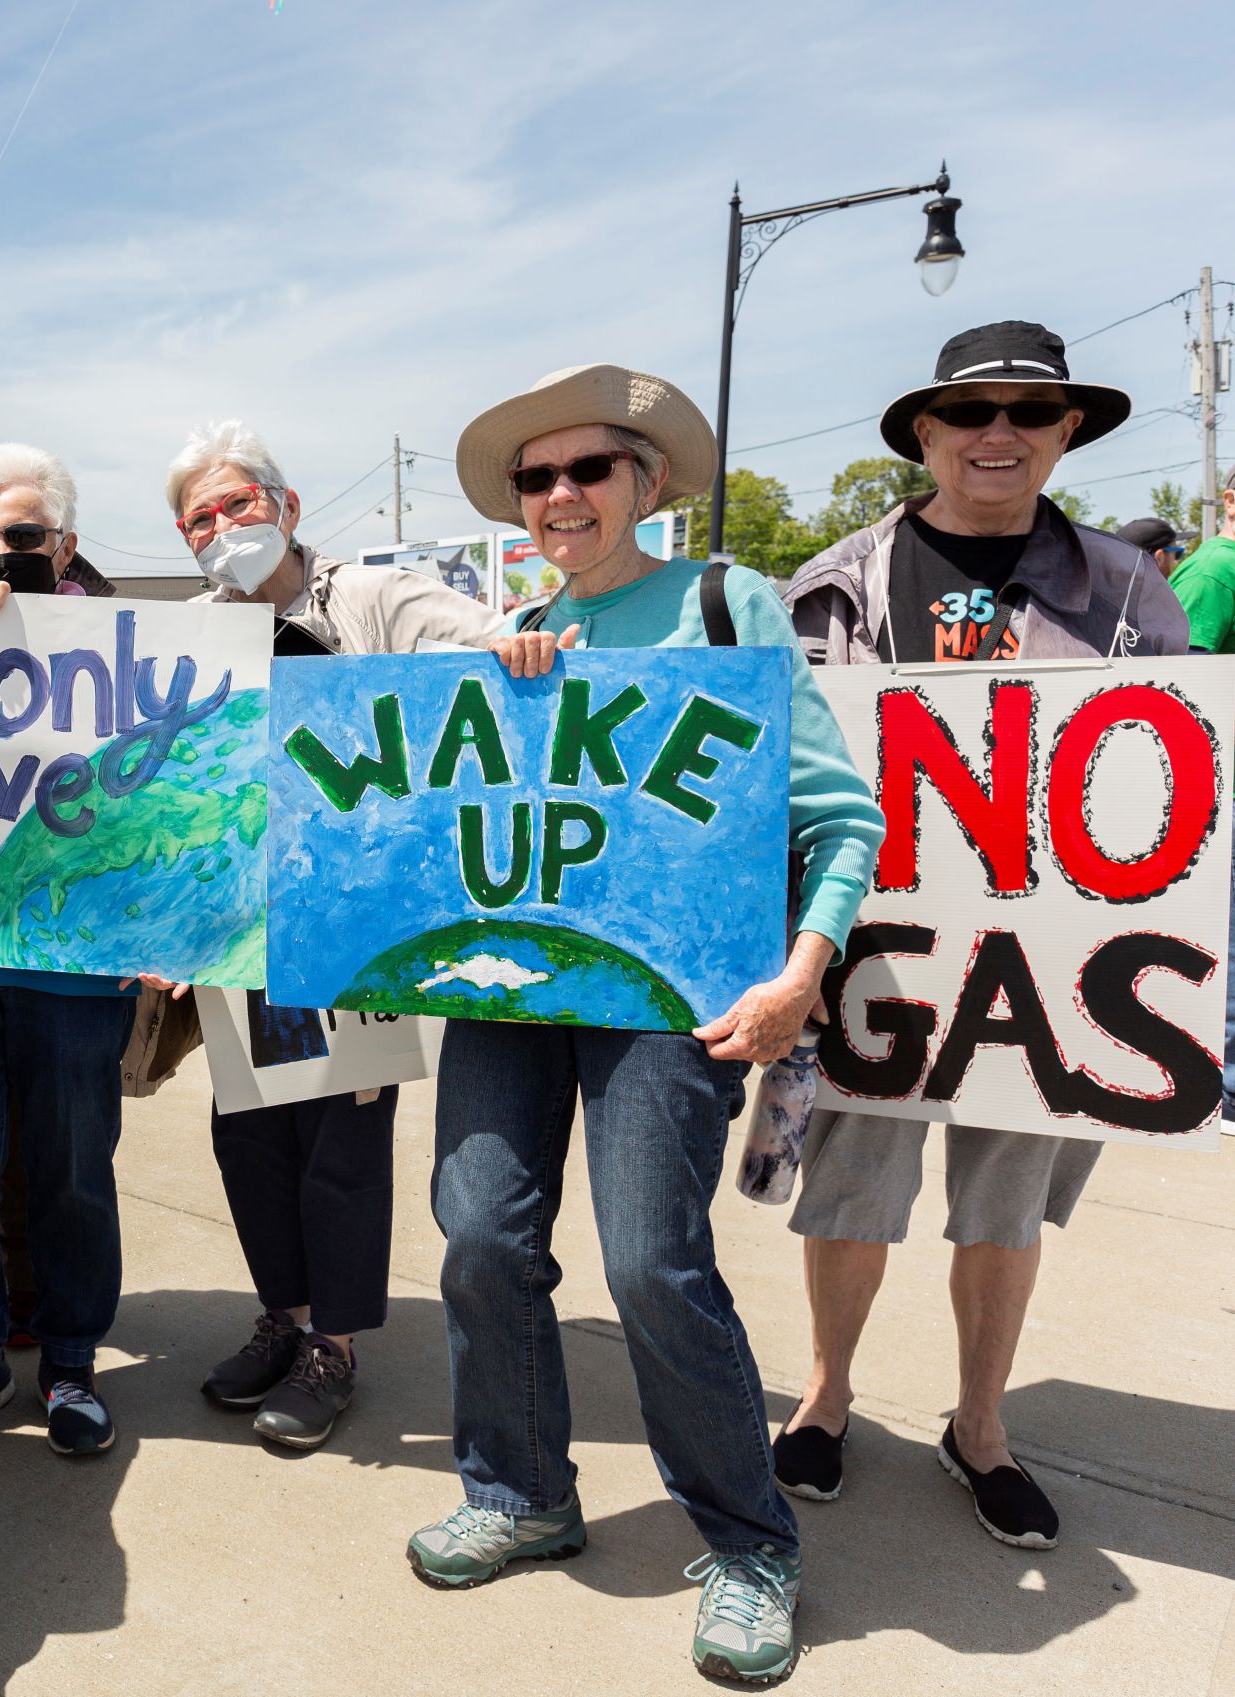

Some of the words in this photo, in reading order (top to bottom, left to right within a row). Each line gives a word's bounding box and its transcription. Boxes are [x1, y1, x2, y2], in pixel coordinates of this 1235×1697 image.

[452, 571, 470, 581] BUY
[452, 582, 470, 591] SELL
[284, 677, 765, 825] WAKE
[874, 679, 1223, 905] NO
[458, 801, 607, 908] UP
[816, 921, 1225, 1135] GAS
